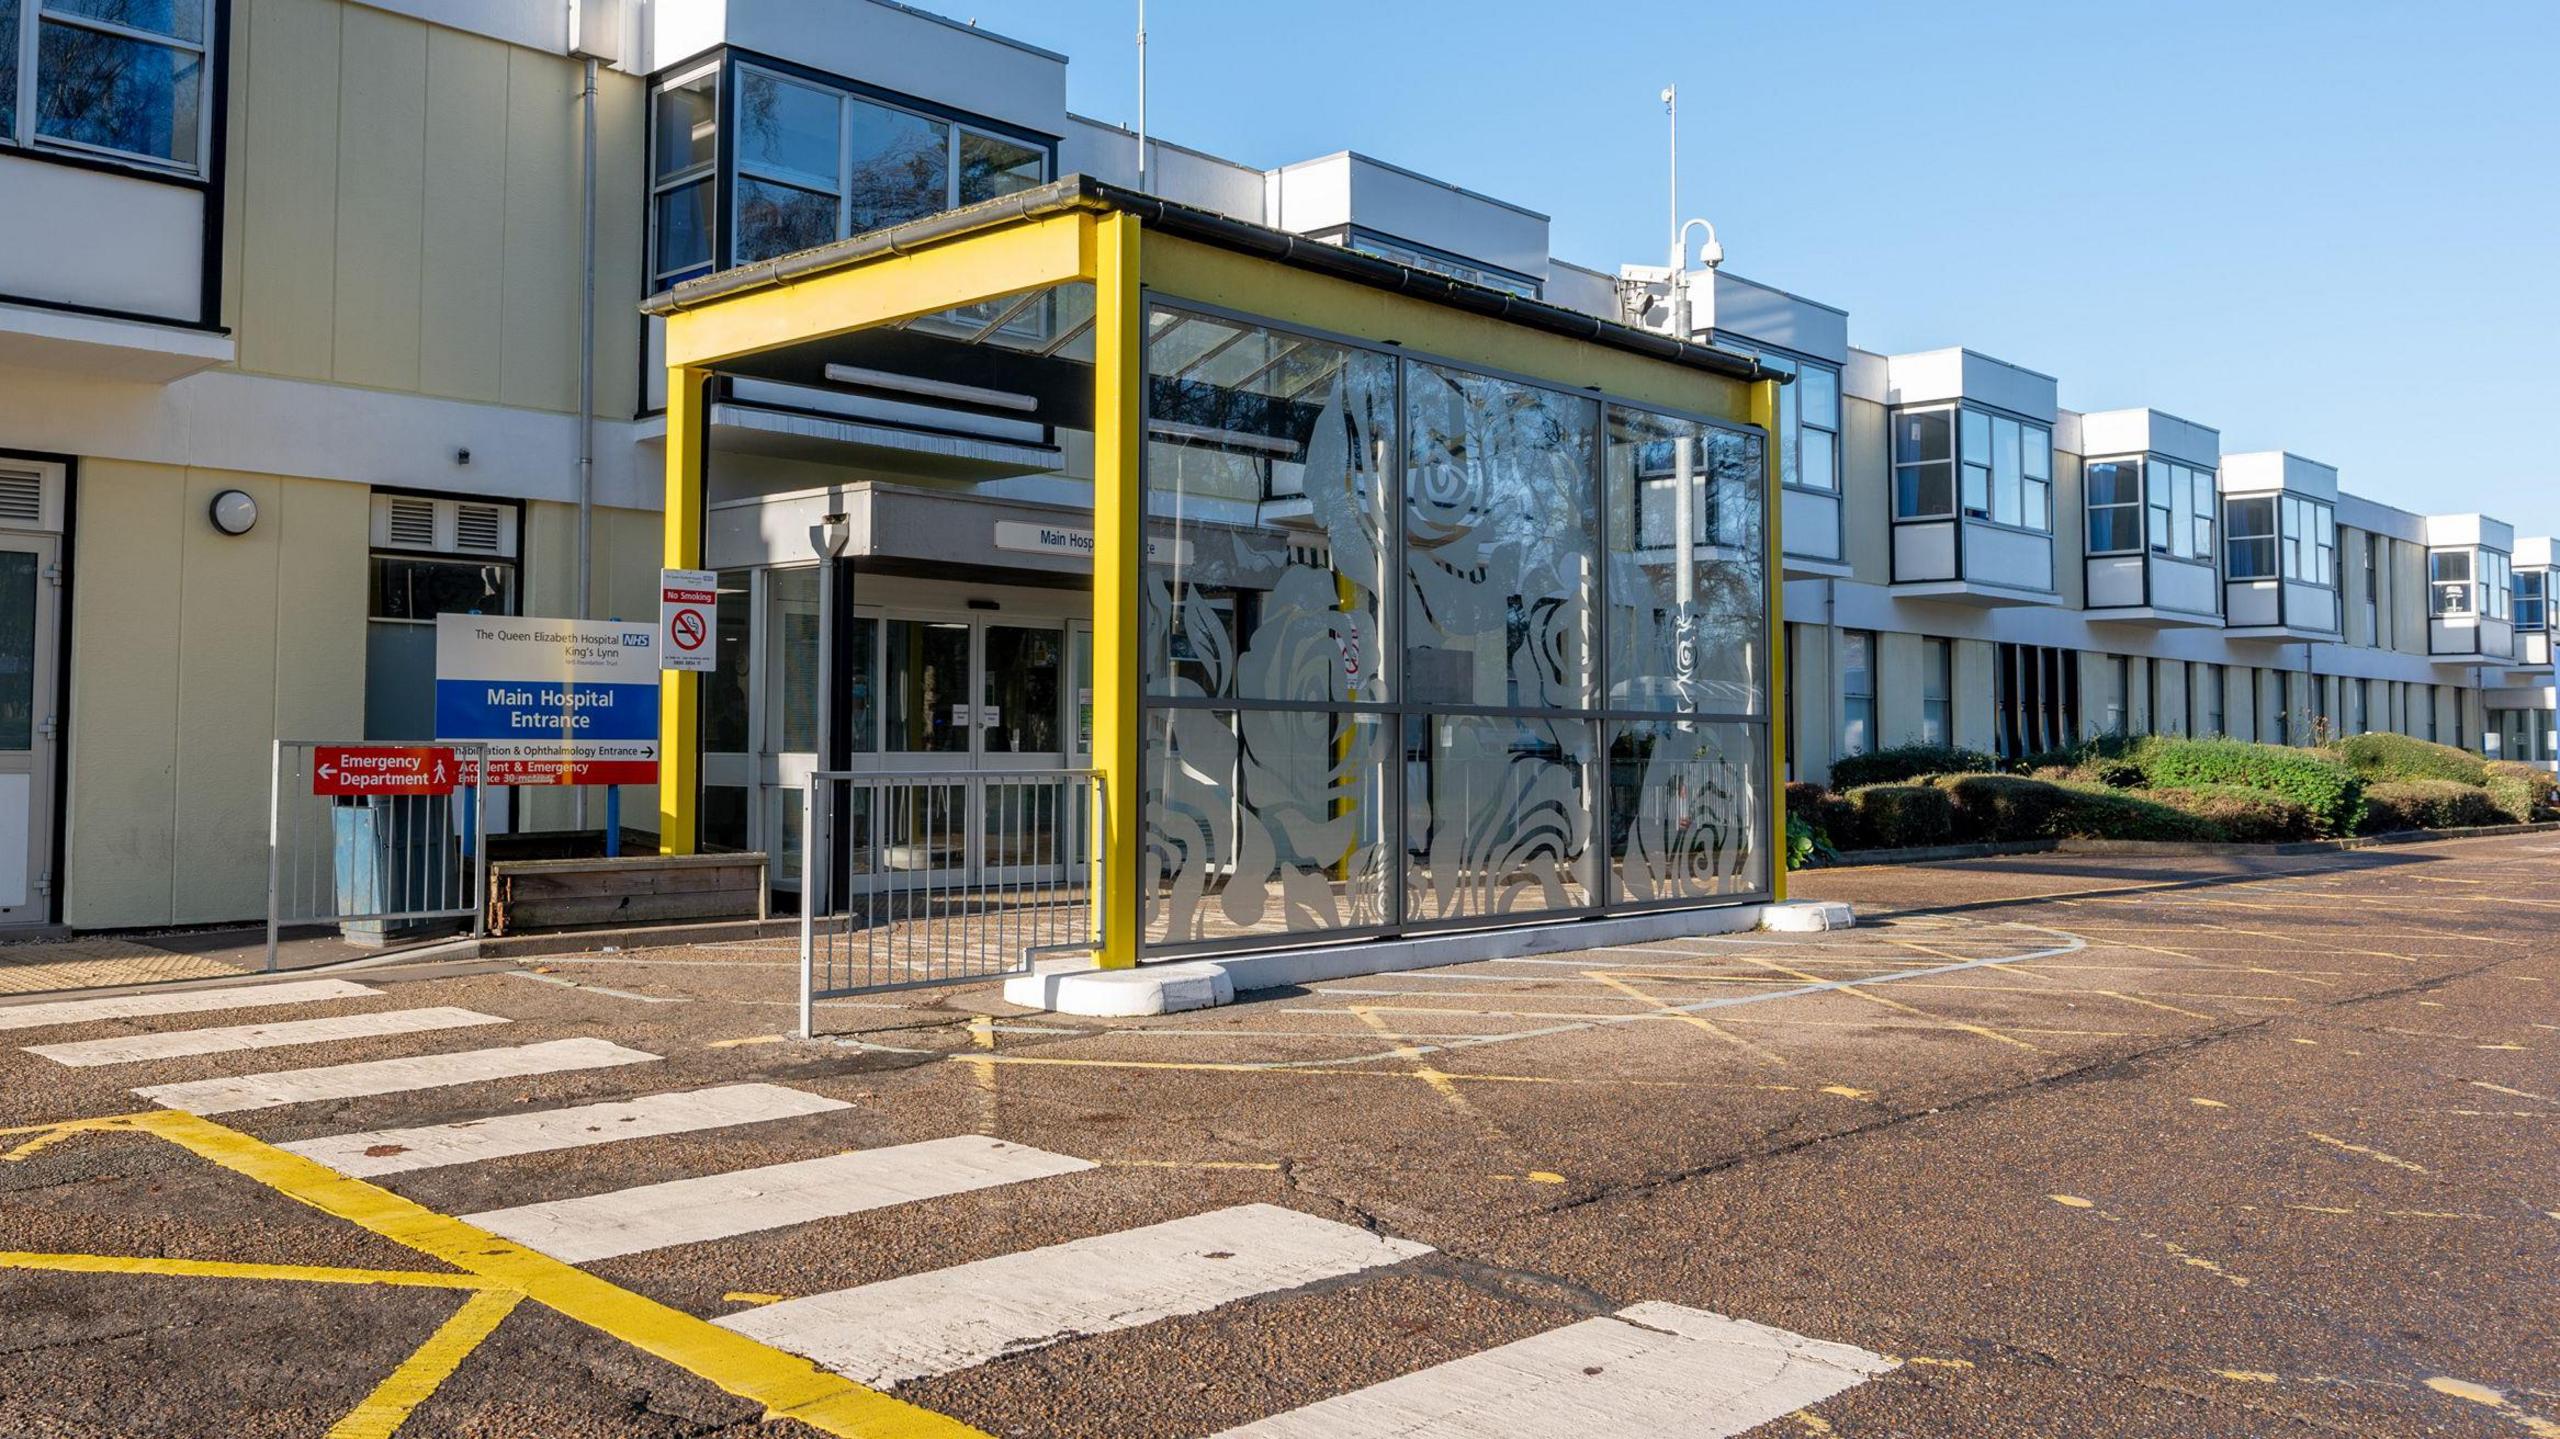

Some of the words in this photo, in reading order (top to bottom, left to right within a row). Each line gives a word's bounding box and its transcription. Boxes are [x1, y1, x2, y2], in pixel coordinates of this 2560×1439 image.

[1040, 529, 1066, 545] Main
[1070, 533, 1095, 552] Hosp
[667, 591, 679, 599] No
[680, 592, 712, 603] Smoking
[475, 629, 494, 640] The
[498, 630, 531, 642] Queen
[534, 631, 578, 643] Elizabeth
[581, 633, 619, 645] Hospital
[624, 635, 649, 646] NHS
[565, 646, 593, 659] King's
[597, 647, 619, 659] Lynn
[487, 688, 533, 706] Main
[541, 690, 614, 710] Hospital
[511, 711, 590, 729] Entrance
[455, 745, 511, 756] habiation
[513, 746, 521, 756] &
[524, 745, 596, 759] Ophthalmology
[598, 746, 638, 757] Entrance
[340, 754, 421, 771] Emergency
[459, 761, 509, 773] Accent
[514, 761, 523, 772] &
[527, 762, 589, 774] Emergency
[340, 771, 429, 787] Department
[458, 773, 500, 783] Entrce
